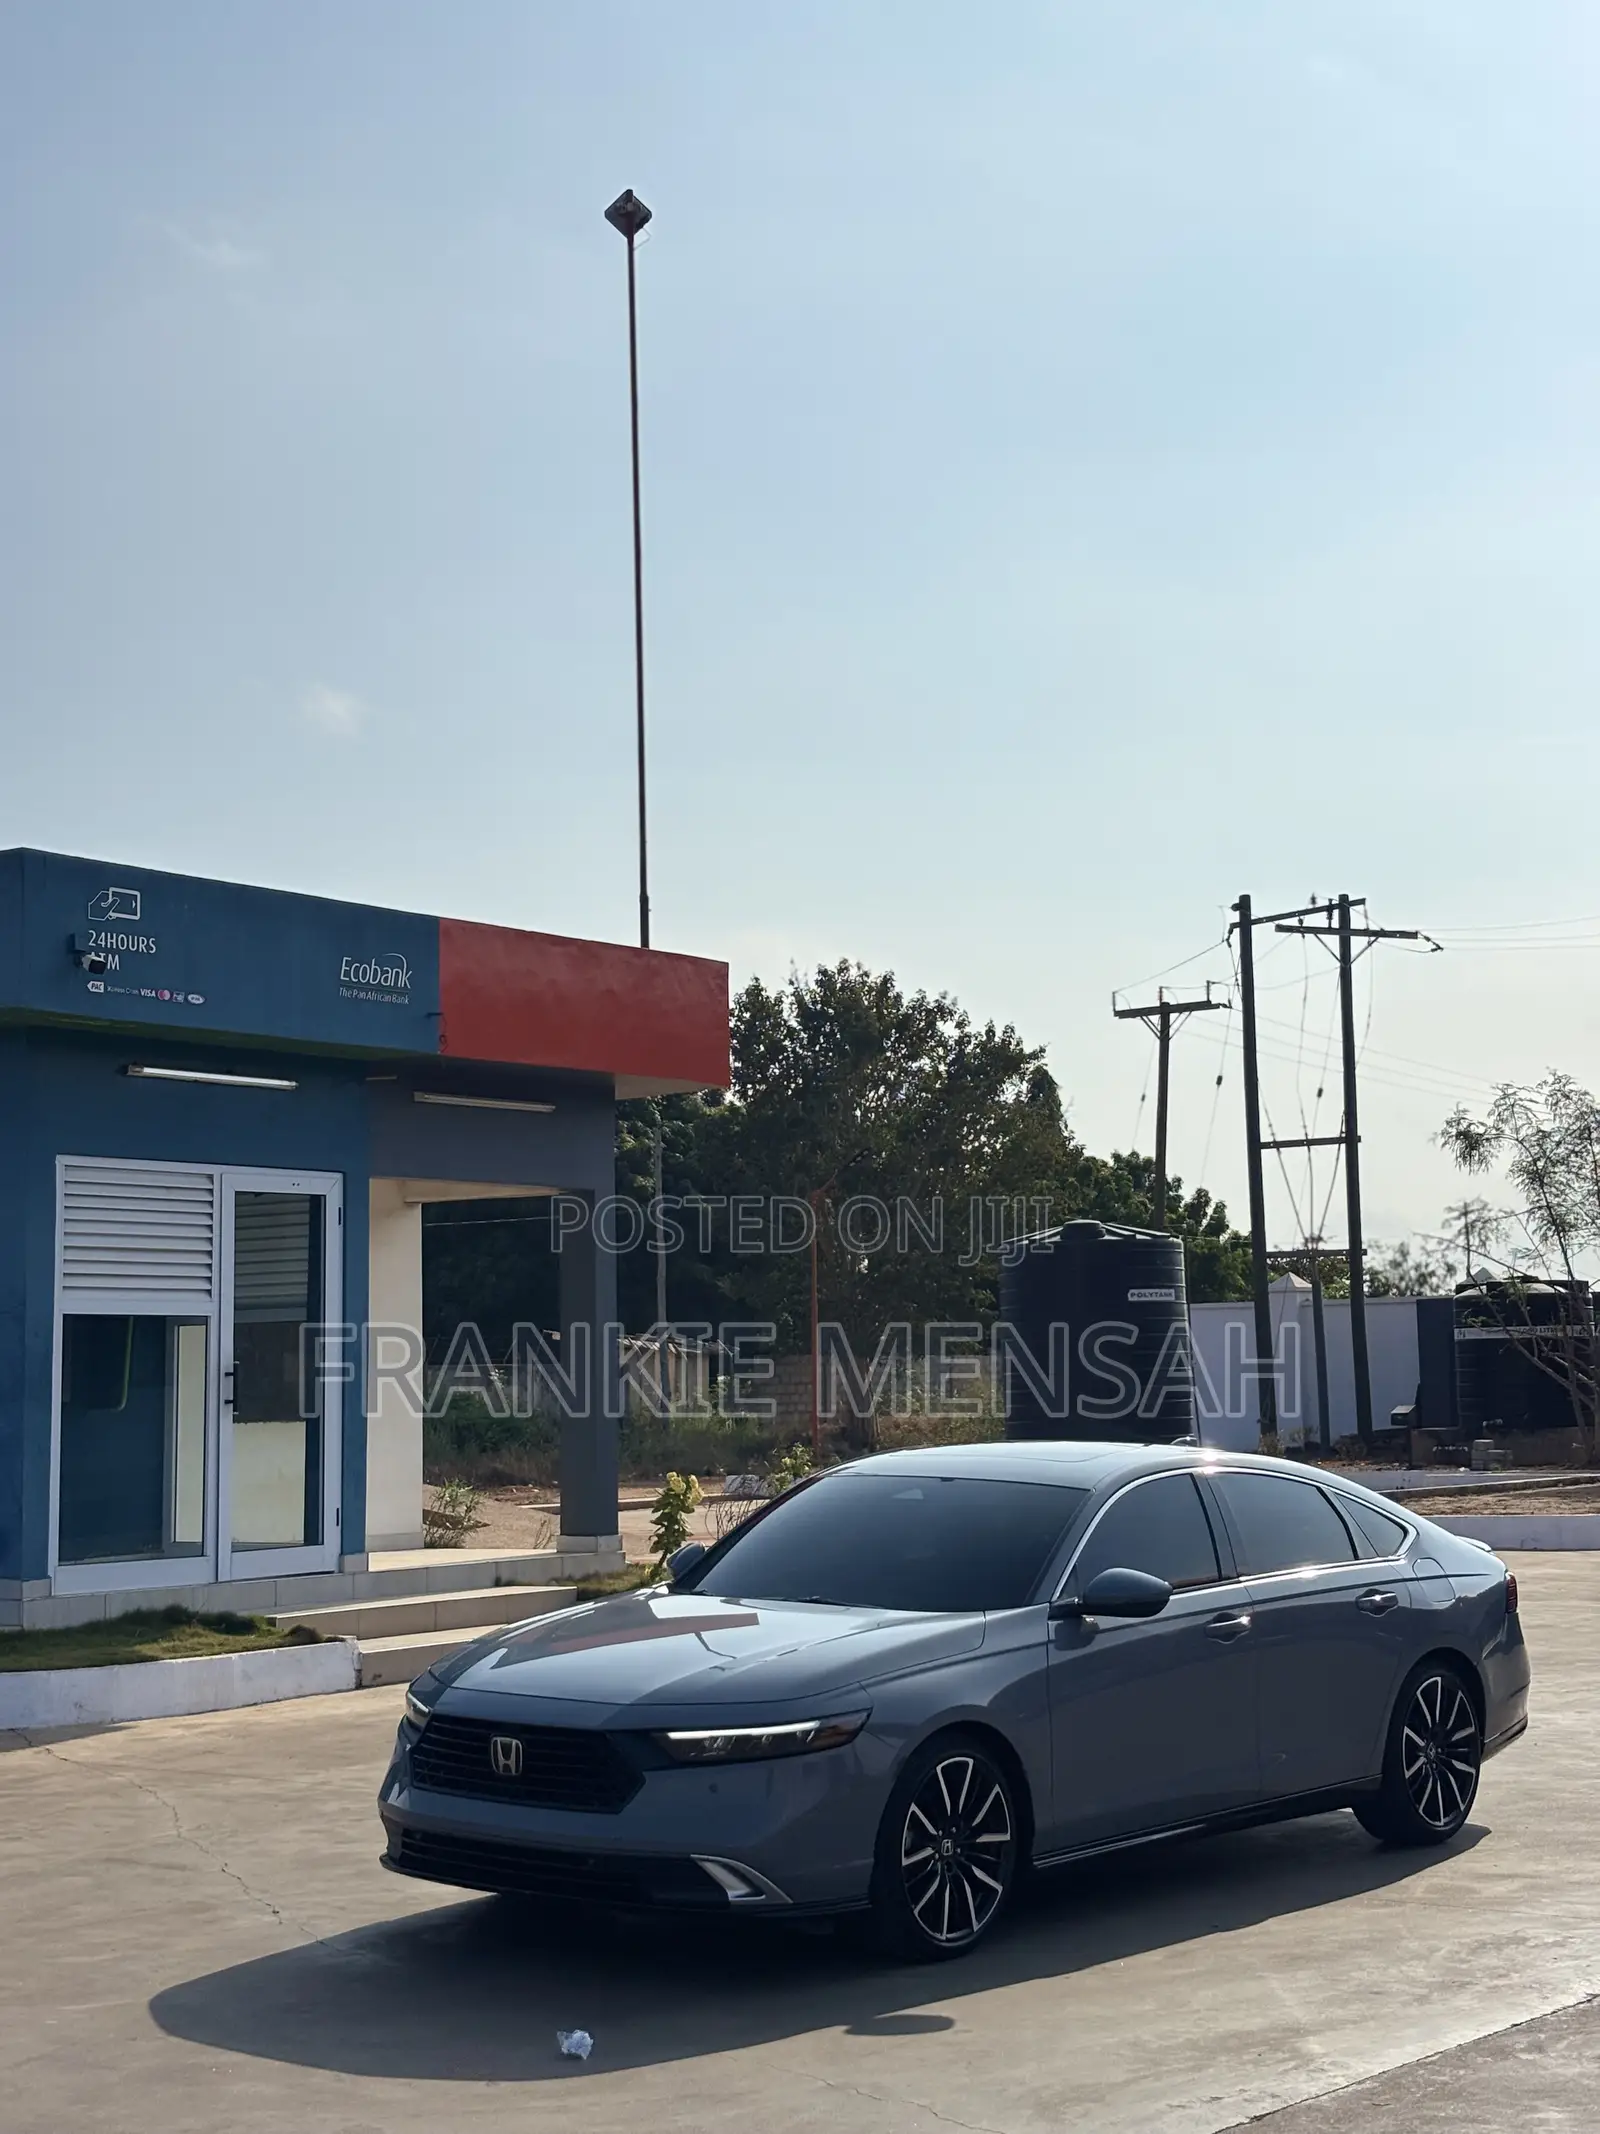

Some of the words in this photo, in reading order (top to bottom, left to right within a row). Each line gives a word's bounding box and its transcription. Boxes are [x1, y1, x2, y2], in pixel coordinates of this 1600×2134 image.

[88, 929, 156, 954] 24HOURS
[340, 952, 413, 989] Ecobank
[140, 988, 156, 998] VISA
[339, 987, 352, 998] The
[352, 989, 366, 999] Pan
[366, 991, 391, 1003] African
[391, 993, 409, 1005] Bank
[1130, 1291, 1173, 1299] POLYTANK
